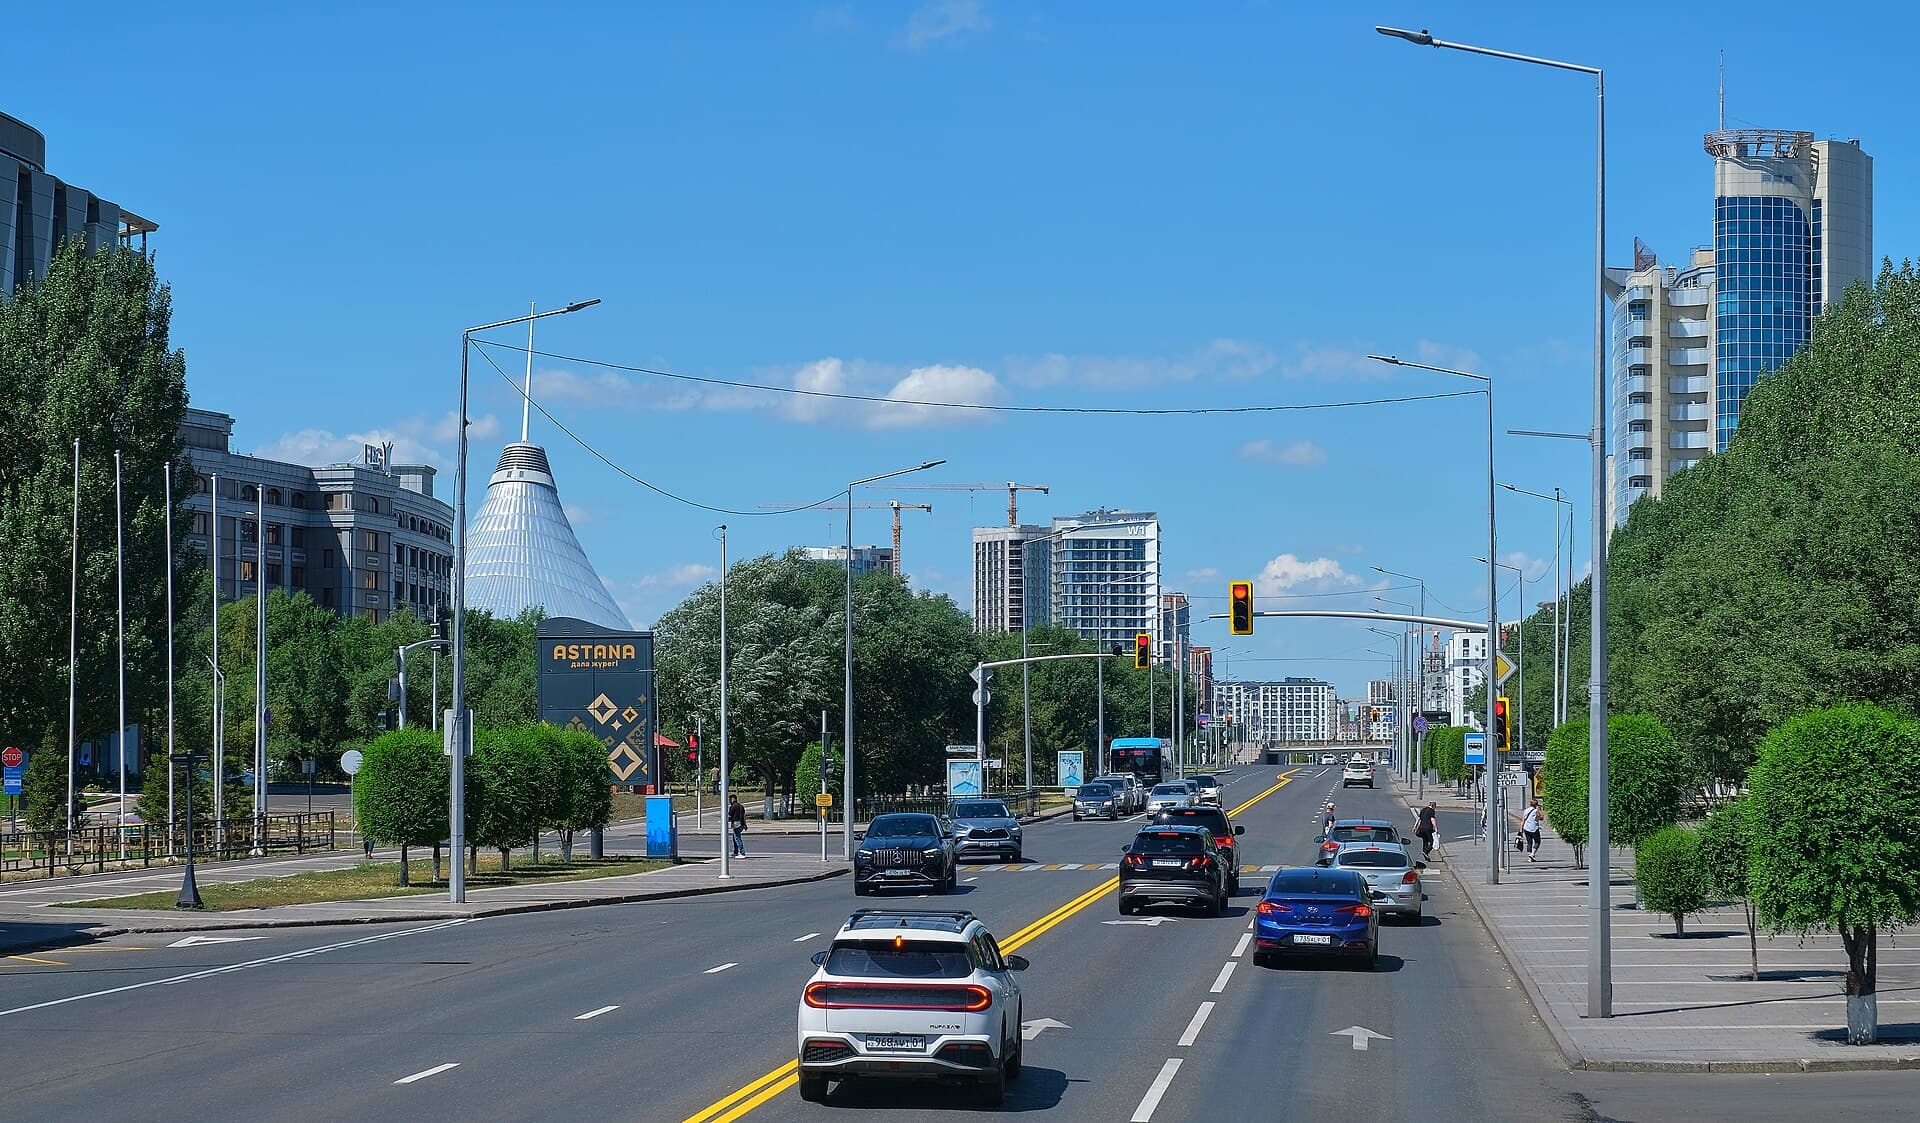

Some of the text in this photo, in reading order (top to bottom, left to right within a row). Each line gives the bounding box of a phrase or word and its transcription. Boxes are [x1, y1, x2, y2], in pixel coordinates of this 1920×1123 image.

[1127, 525, 1145, 536] W1
[553, 644, 636, 660] ASTANA
[570, 661, 590, 669] дала
[3, 753, 22, 761] STOP
